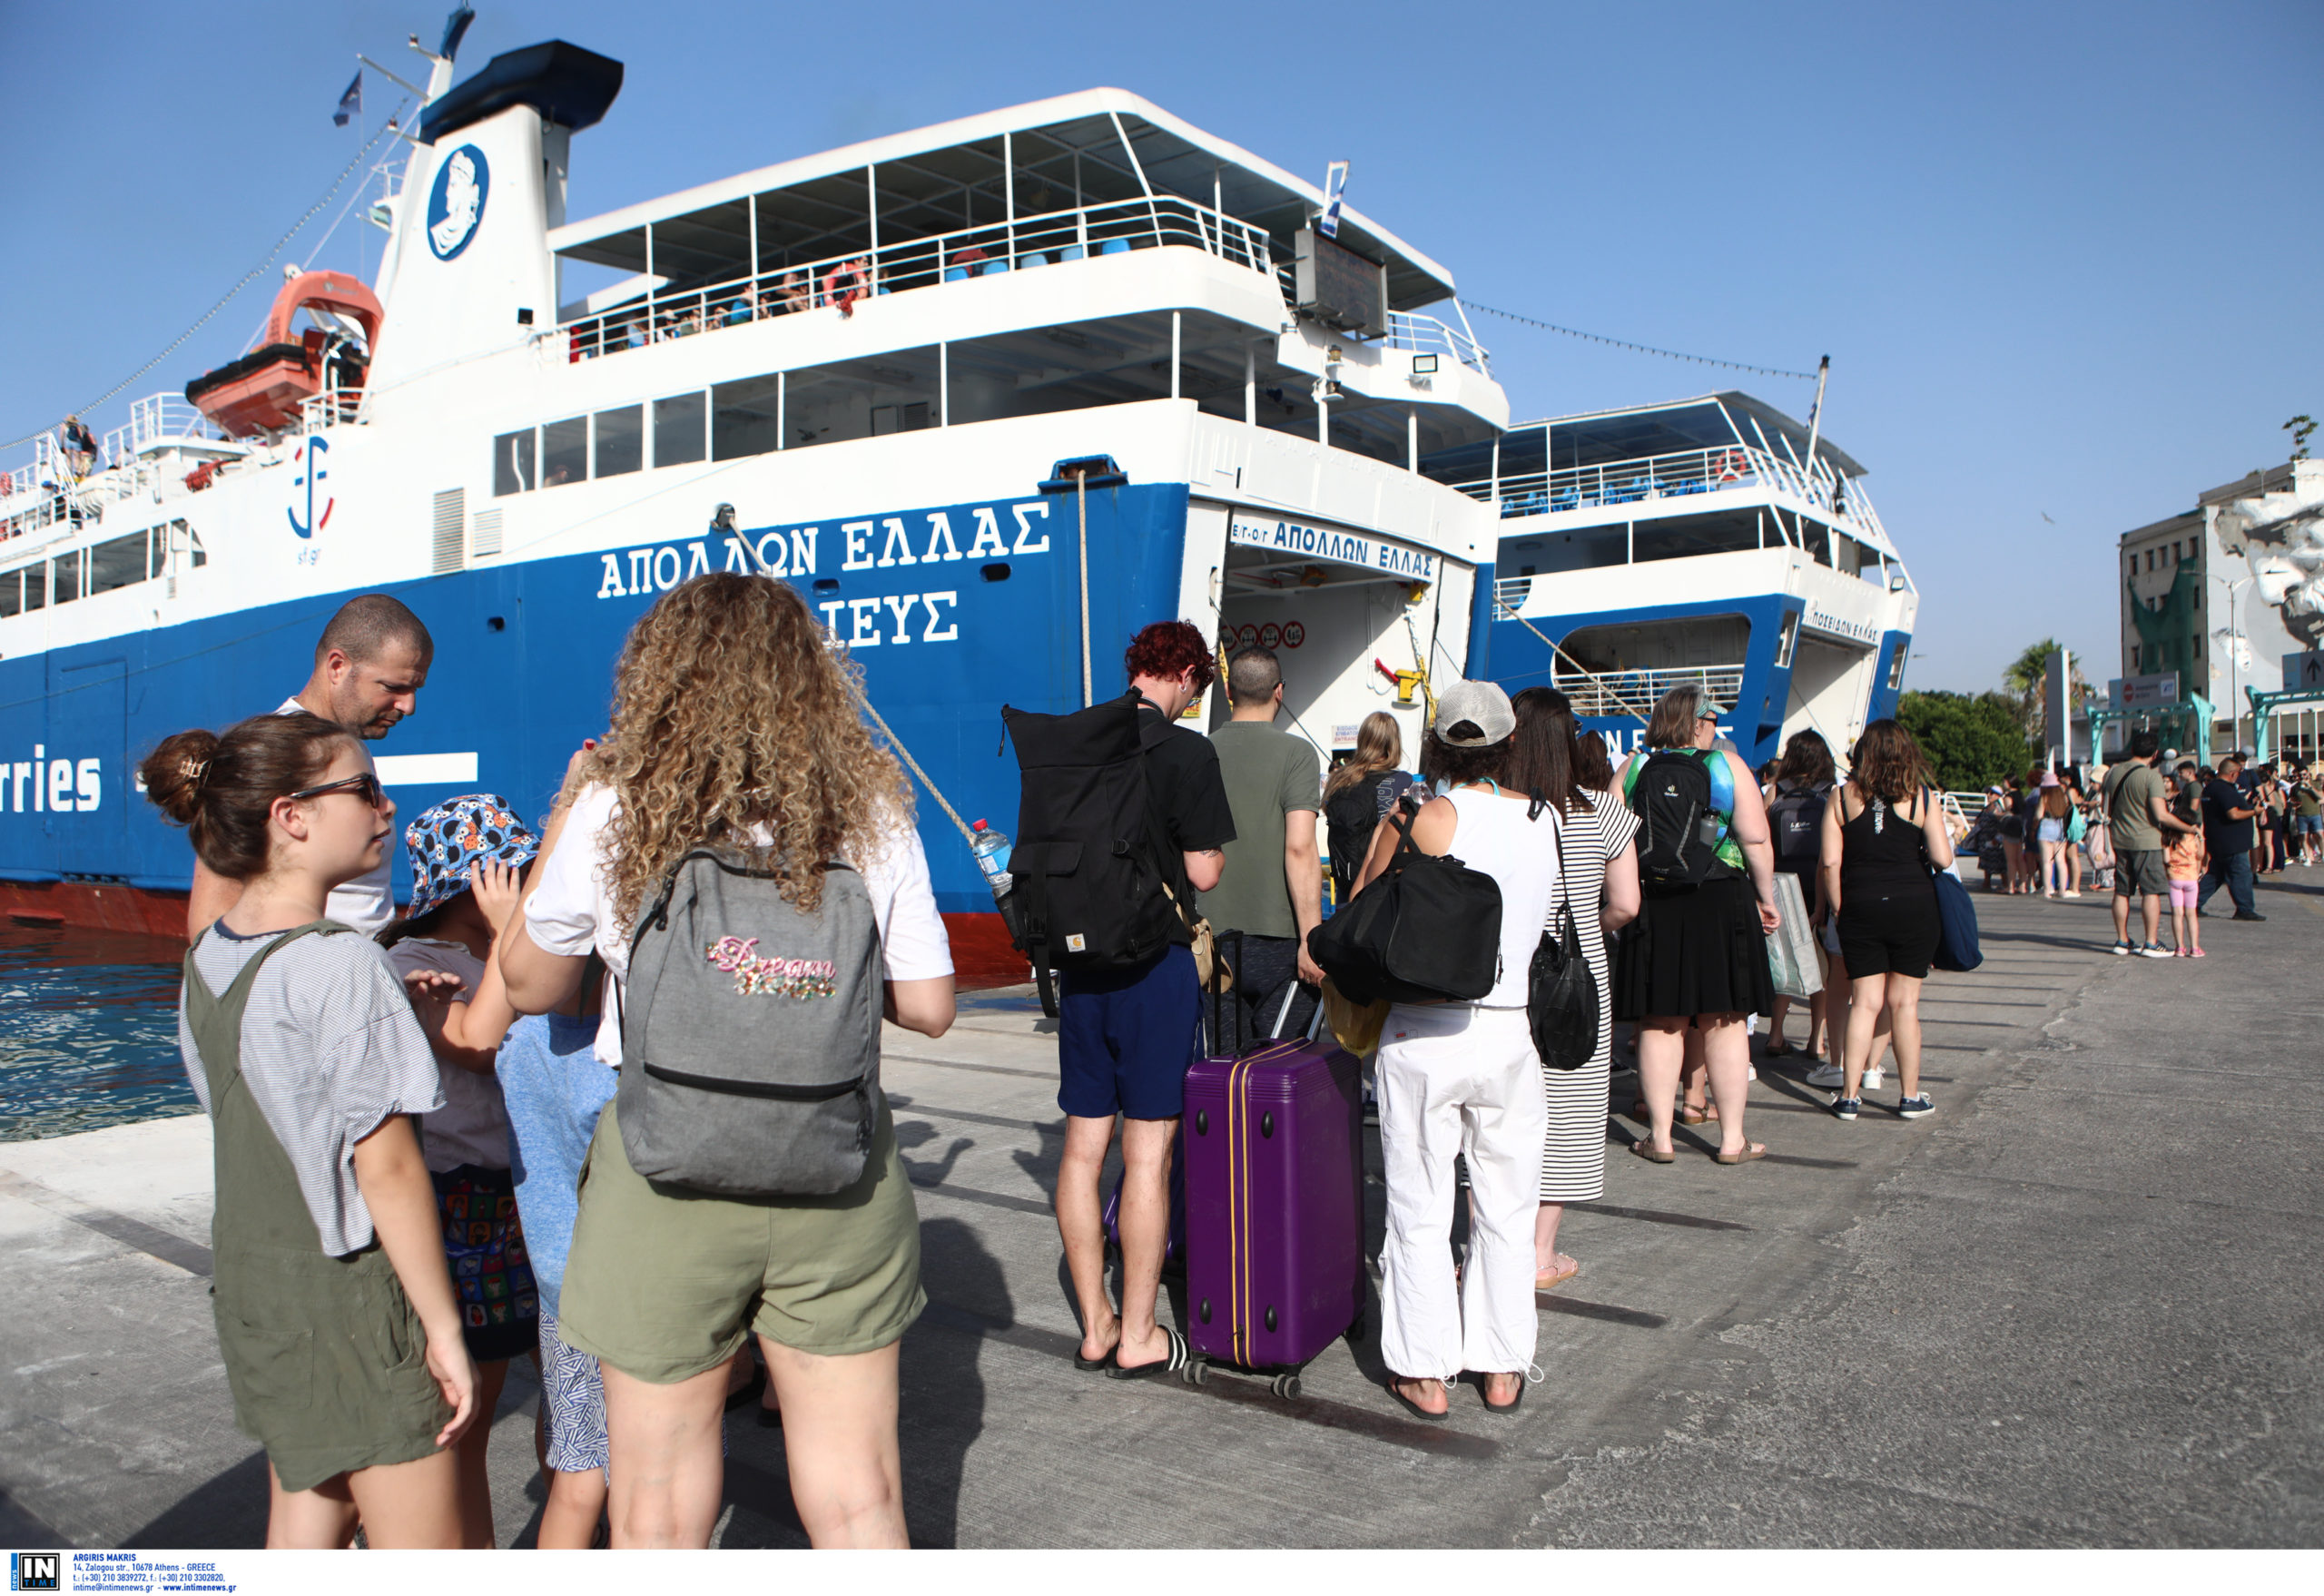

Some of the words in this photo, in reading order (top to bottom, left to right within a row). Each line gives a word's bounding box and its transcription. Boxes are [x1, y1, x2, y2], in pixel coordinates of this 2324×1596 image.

[597, 527, 819, 598] ΑΠΟΛΛΩΝ
[841, 501, 1049, 571] ΕΛΛΑΣ
[1274, 522, 1369, 564] ΑΠΟΛΛΩΝ
[1379, 545, 1433, 577] ΕΛΛΑΣ
[1813, 611, 1852, 634] ΠΟΣΕΙΔΩΝ
[1853, 624, 1877, 642] ΕΛΛΑΣ
[717, 935, 837, 980] Dream
